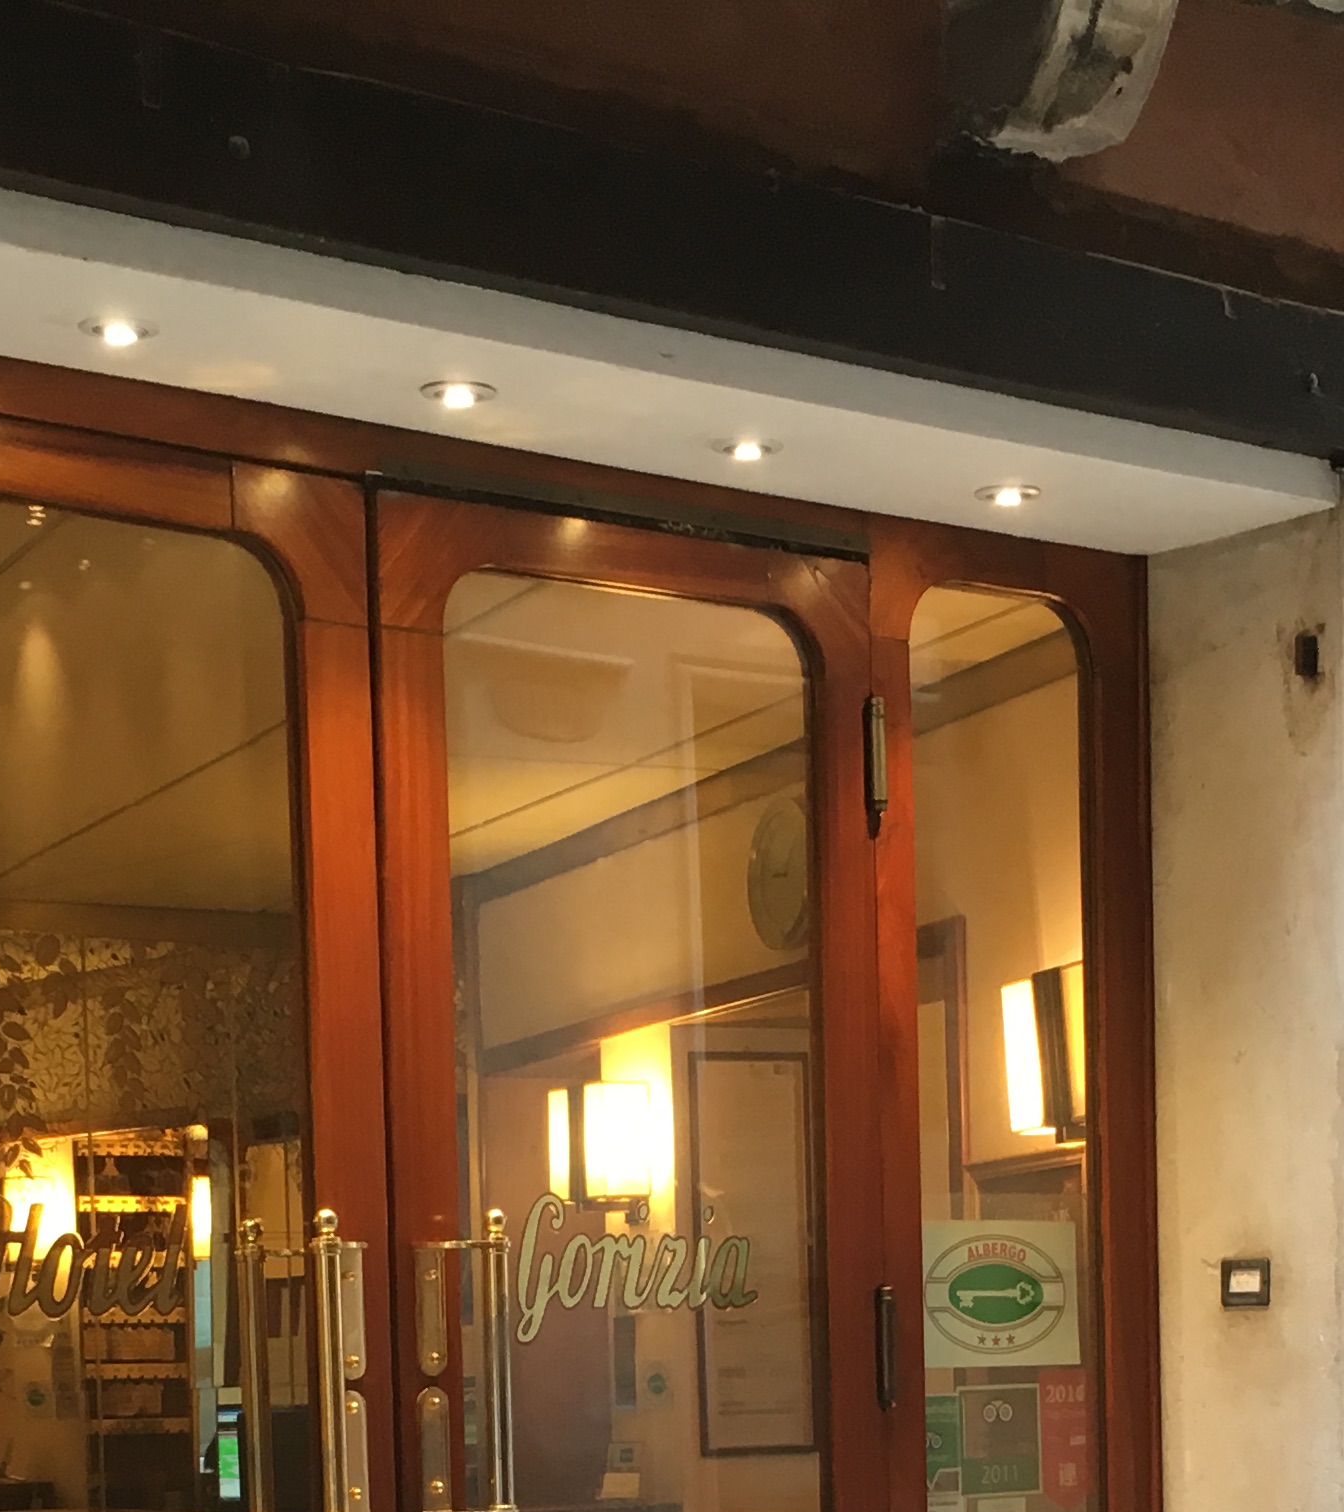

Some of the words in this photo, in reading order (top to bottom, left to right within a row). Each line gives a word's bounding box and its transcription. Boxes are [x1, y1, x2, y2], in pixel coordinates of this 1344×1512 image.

[967, 1242, 1027, 1265] ALBERGO
[516, 1192, 758, 1344] Gorizia
[981, 1464, 1019, 1485] 2011
